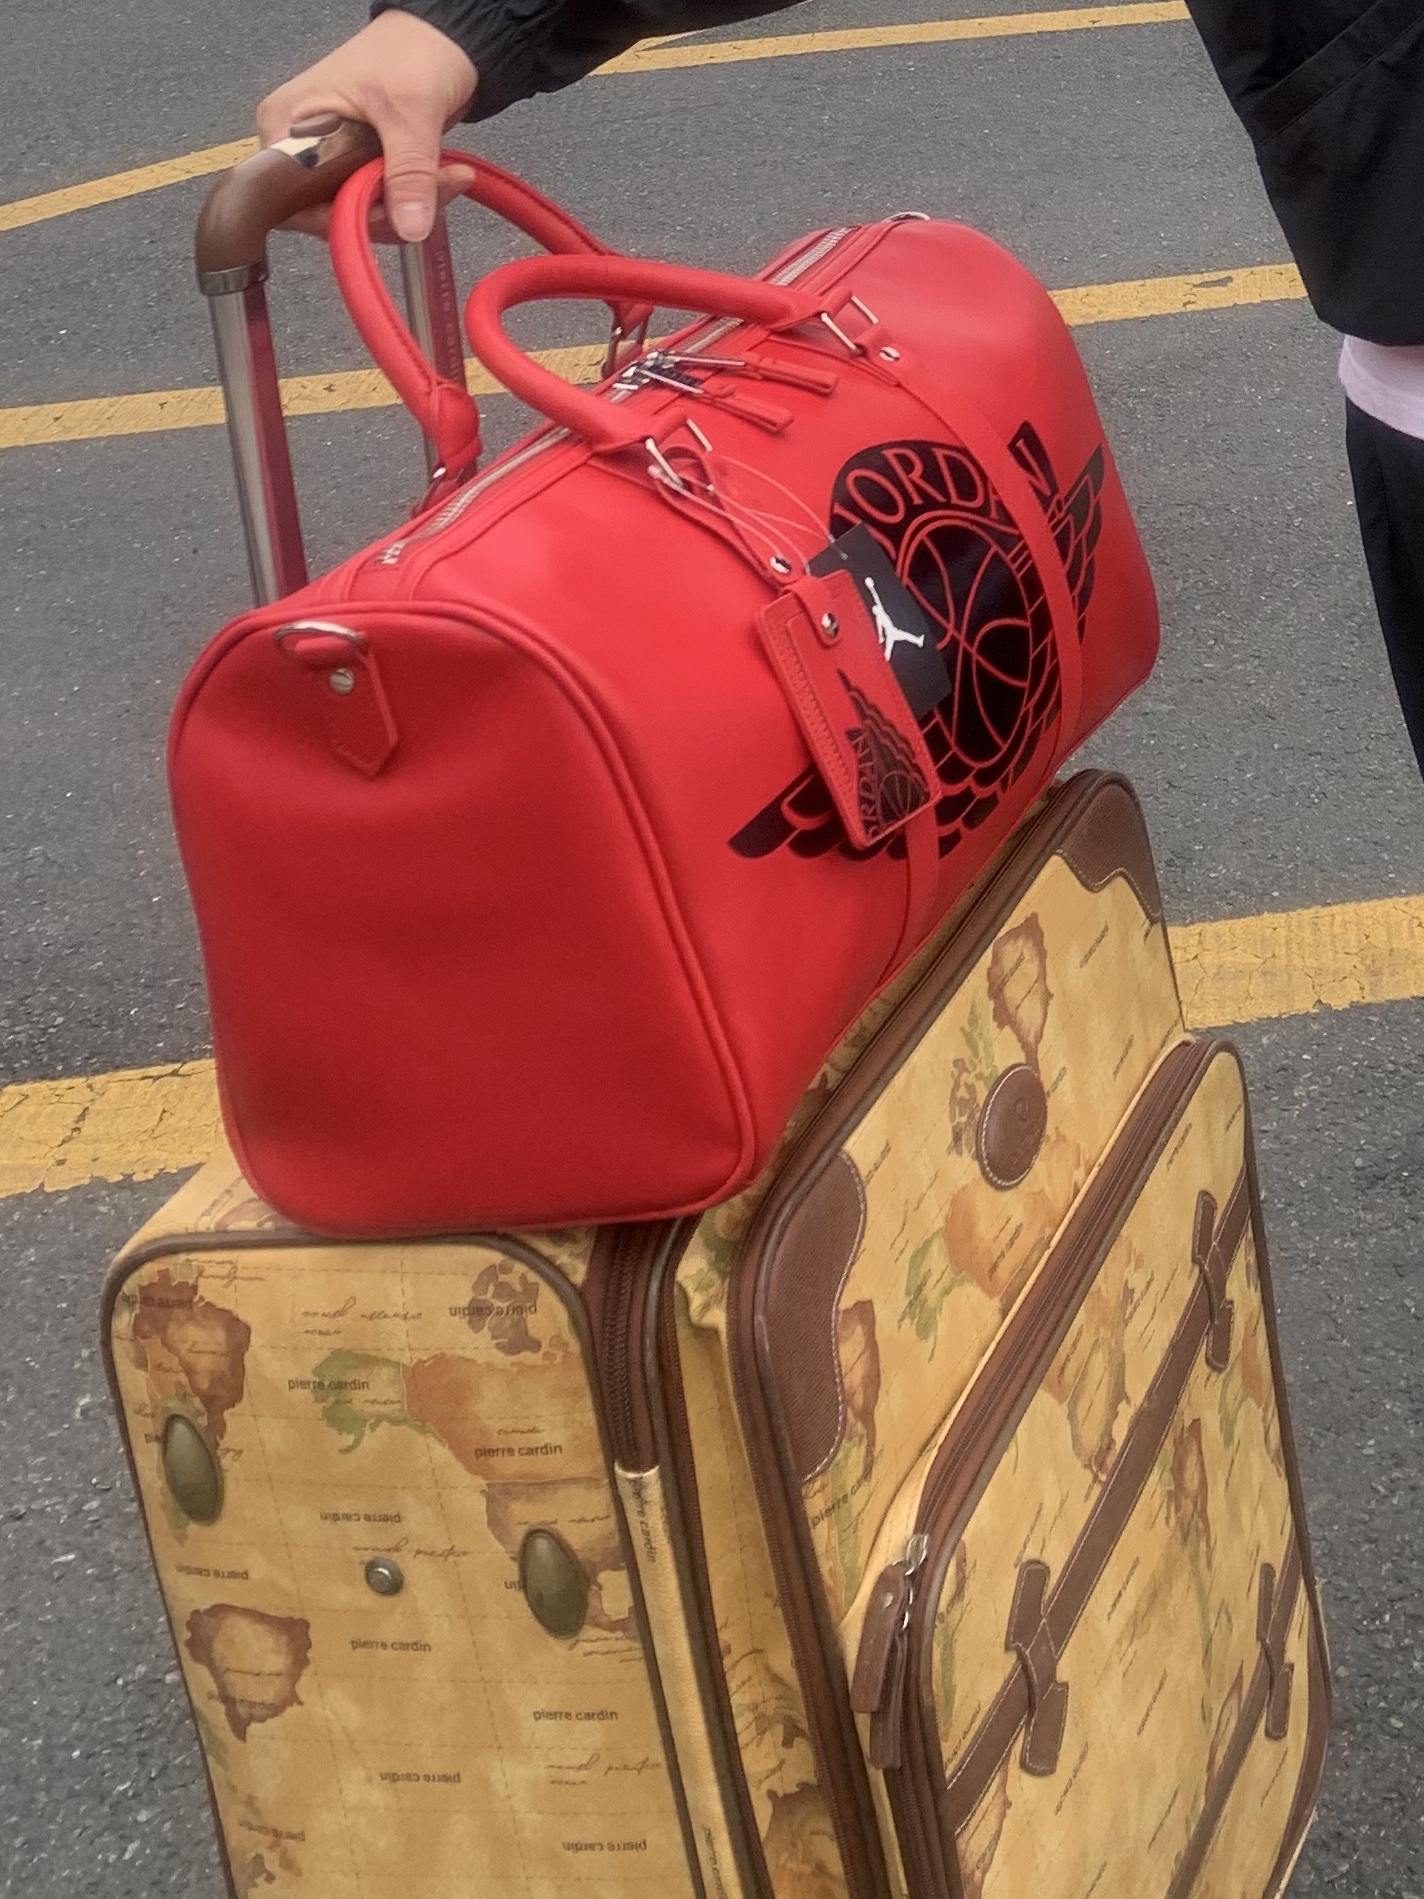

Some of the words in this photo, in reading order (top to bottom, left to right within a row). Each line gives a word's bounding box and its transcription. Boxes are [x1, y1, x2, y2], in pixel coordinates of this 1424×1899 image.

[833, 438, 1052, 561] JORDN
[287, 1378, 325, 1392] pierre
[328, 1379, 370, 1392] cardin
[474, 1444, 515, 1460] pierre
[518, 1442, 563, 1457] cardin
[351, 1638, 388, 1652] pierre
[391, 1639, 431, 1653] cardin
[533, 1709, 573, 1722] pierre
[575, 1709, 619, 1722] cardin
